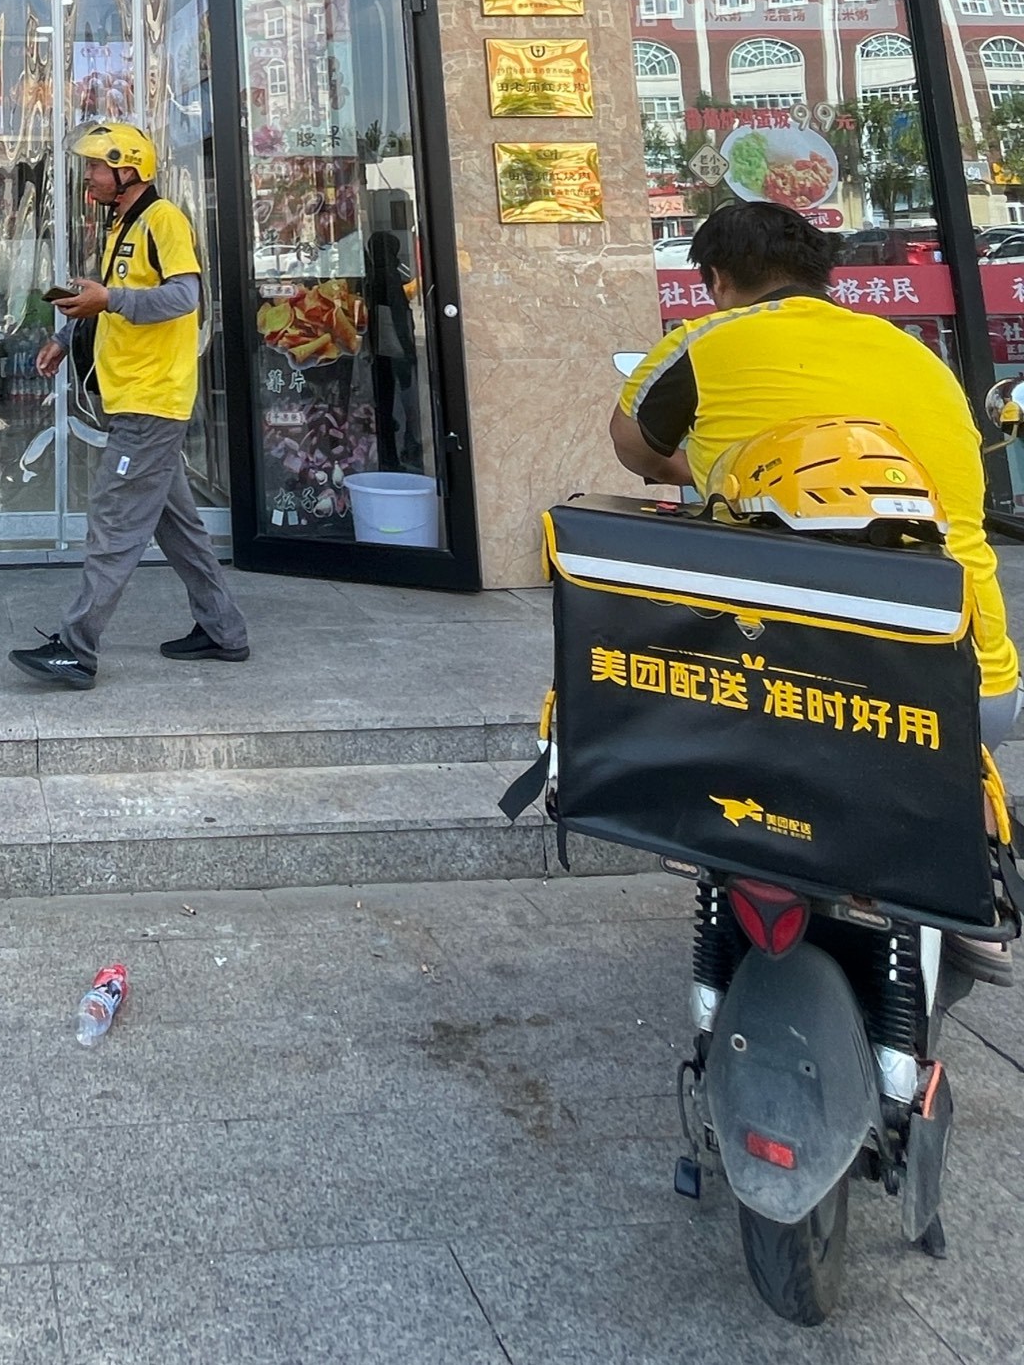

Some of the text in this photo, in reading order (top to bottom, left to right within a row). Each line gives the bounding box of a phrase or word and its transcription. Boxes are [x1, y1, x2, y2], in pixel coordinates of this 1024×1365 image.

[296, 125, 341, 148] 腰果
[265, 369, 306, 394] 薯片
[591, 646, 941, 751] 美团配送 准时好用
[766, 813, 813, 835] 美团配送
